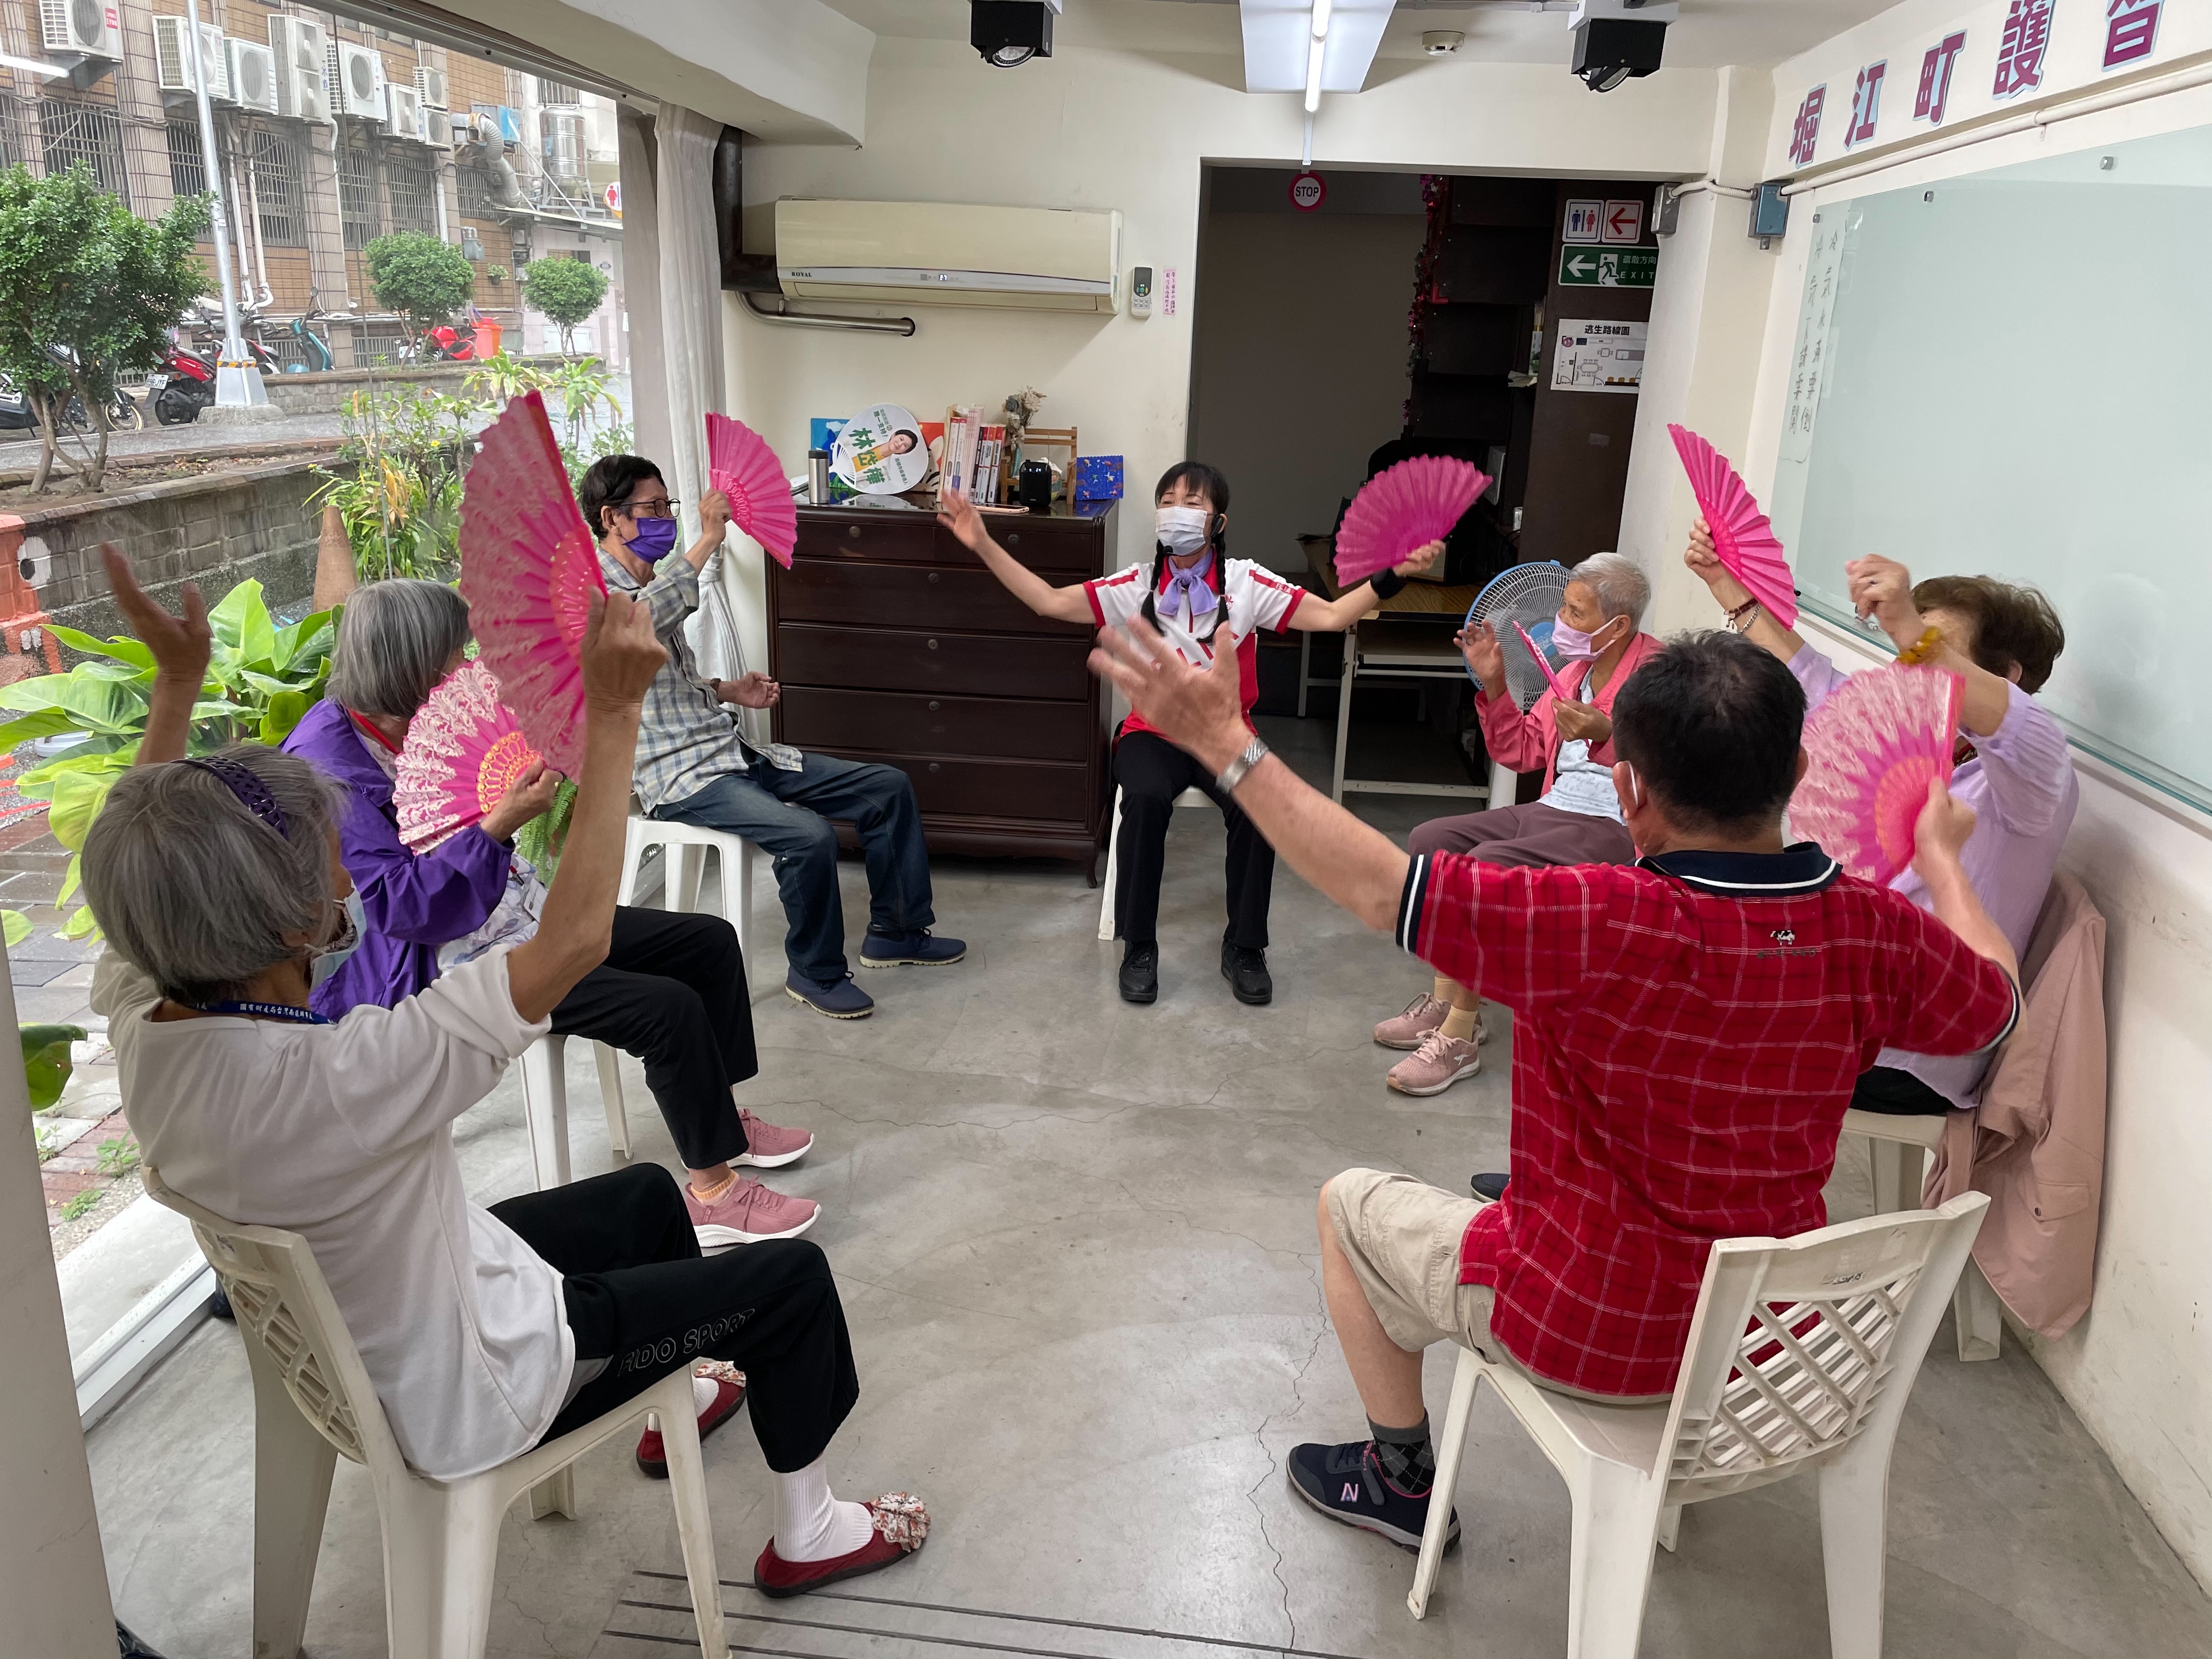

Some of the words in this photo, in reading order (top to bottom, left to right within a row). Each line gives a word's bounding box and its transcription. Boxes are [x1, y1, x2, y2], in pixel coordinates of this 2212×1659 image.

[1295, 186, 1319, 197] STOP
[1622, 255, 1657, 265] 疏散方向
[1620, 271, 1655, 279] EXIT
[1584, 324, 1630, 336] 逃生路線圖
[848, 427, 886, 484] 林岱樺
[683, 1308, 755, 1354] SPORT
[1340, 1482, 1359, 1503] N
